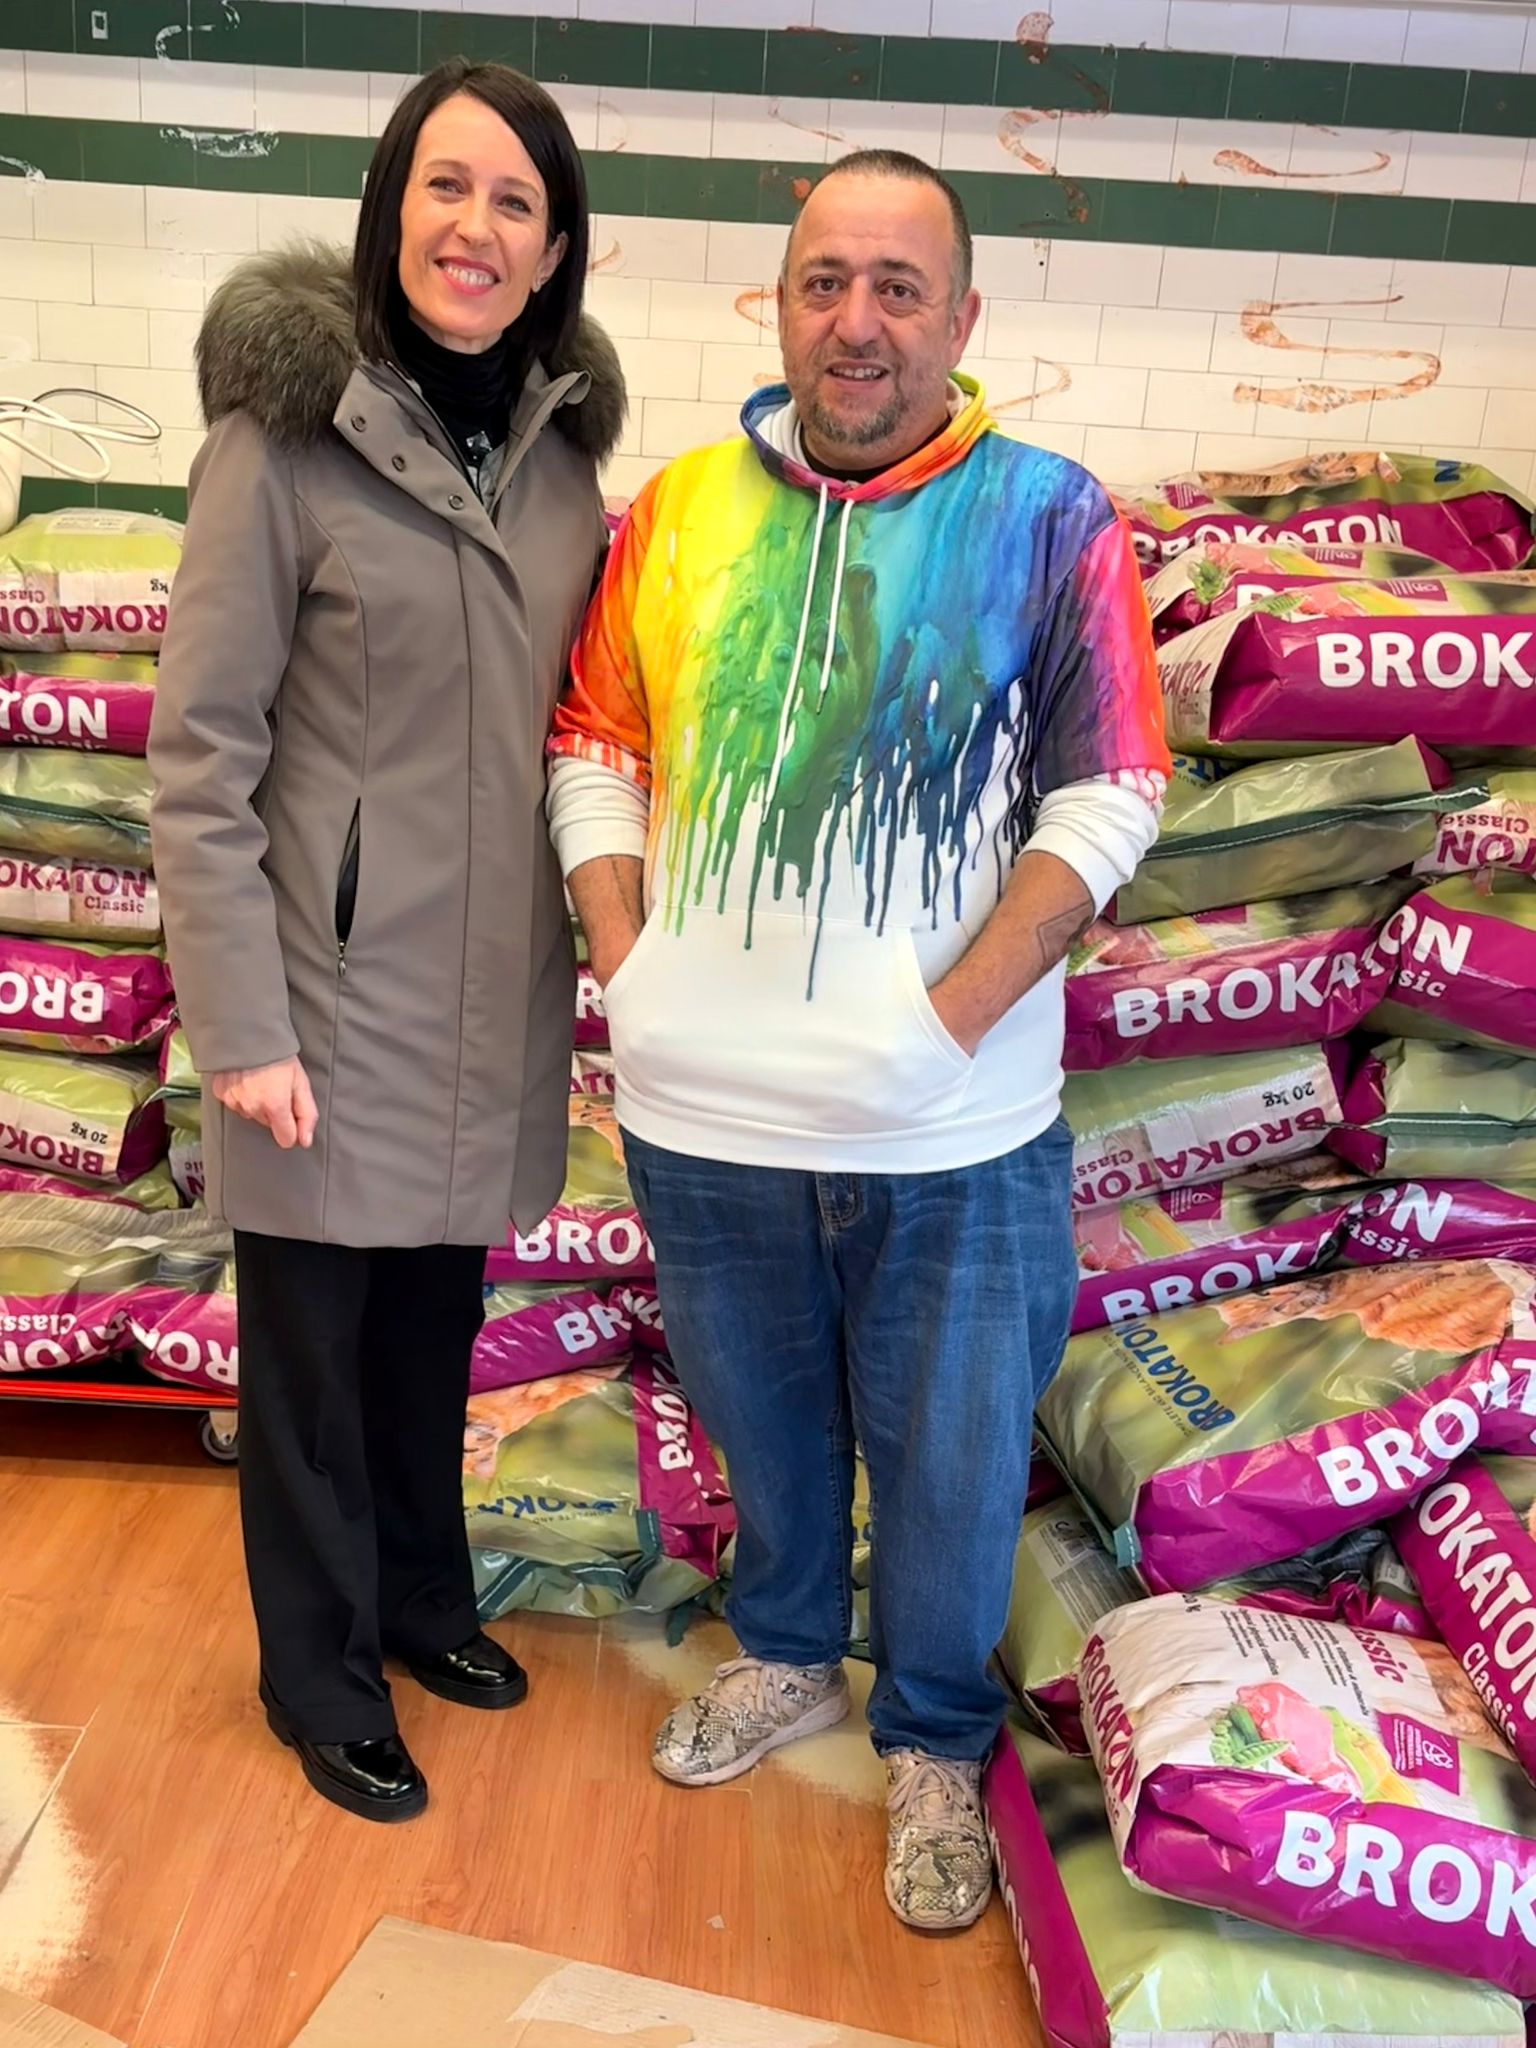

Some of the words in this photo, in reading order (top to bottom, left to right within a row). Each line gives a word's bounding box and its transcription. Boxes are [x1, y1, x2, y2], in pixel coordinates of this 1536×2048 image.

[1317, 632, 1535, 690] BROK
[1443, 813, 1530, 834] Classic
[84, 895, 144, 913] Classic
[1262, 1091, 1290, 1107] kg
[1292, 1081, 1316, 1101] 20
[70, 1121, 87, 1140] kg
[90, 1130, 109, 1145] 20
[0, 1122, 104, 1177] BROK
[514, 1217, 657, 1265] BRO
[1409, 1482, 1536, 1721] OKATON
[1461, 1640, 1518, 1746] Classic
[1275, 1811, 1536, 1946] BROK
